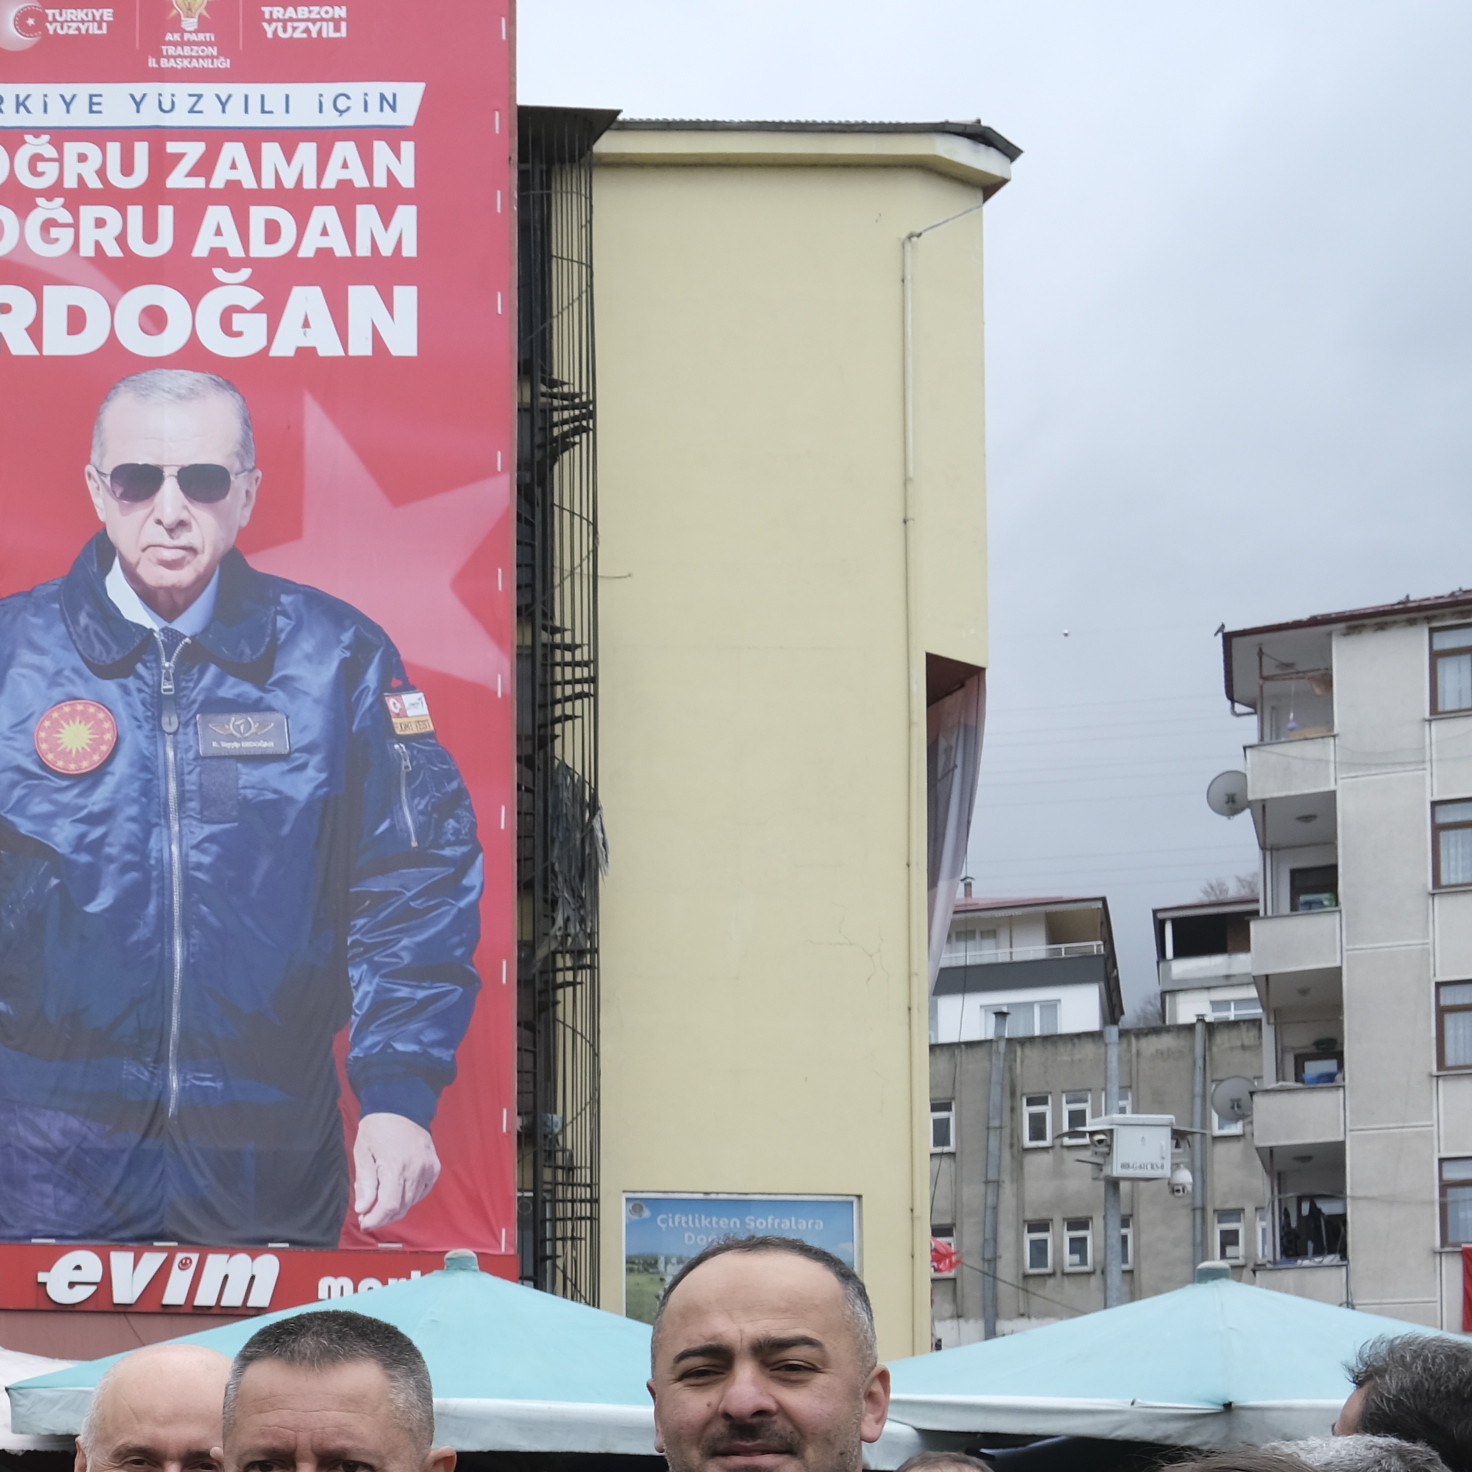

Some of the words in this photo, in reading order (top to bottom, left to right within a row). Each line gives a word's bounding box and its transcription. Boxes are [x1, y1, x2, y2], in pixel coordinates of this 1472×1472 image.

[261, 6, 347, 19] TRABZON
[165, 33, 181, 42] AK
[161, 46, 218, 57] TRABZON
[130, 92, 292, 114] YÜZYILI
[318, 92, 399, 118] İÇİN
[165, 140, 416, 190] ZAMAN
[191, 204, 418, 258] ADAM
[656, 1213, 741, 1231] Çiftlikten
[745, 1215, 824, 1231] Sofralara
[37, 1249, 281, 1308] evim
